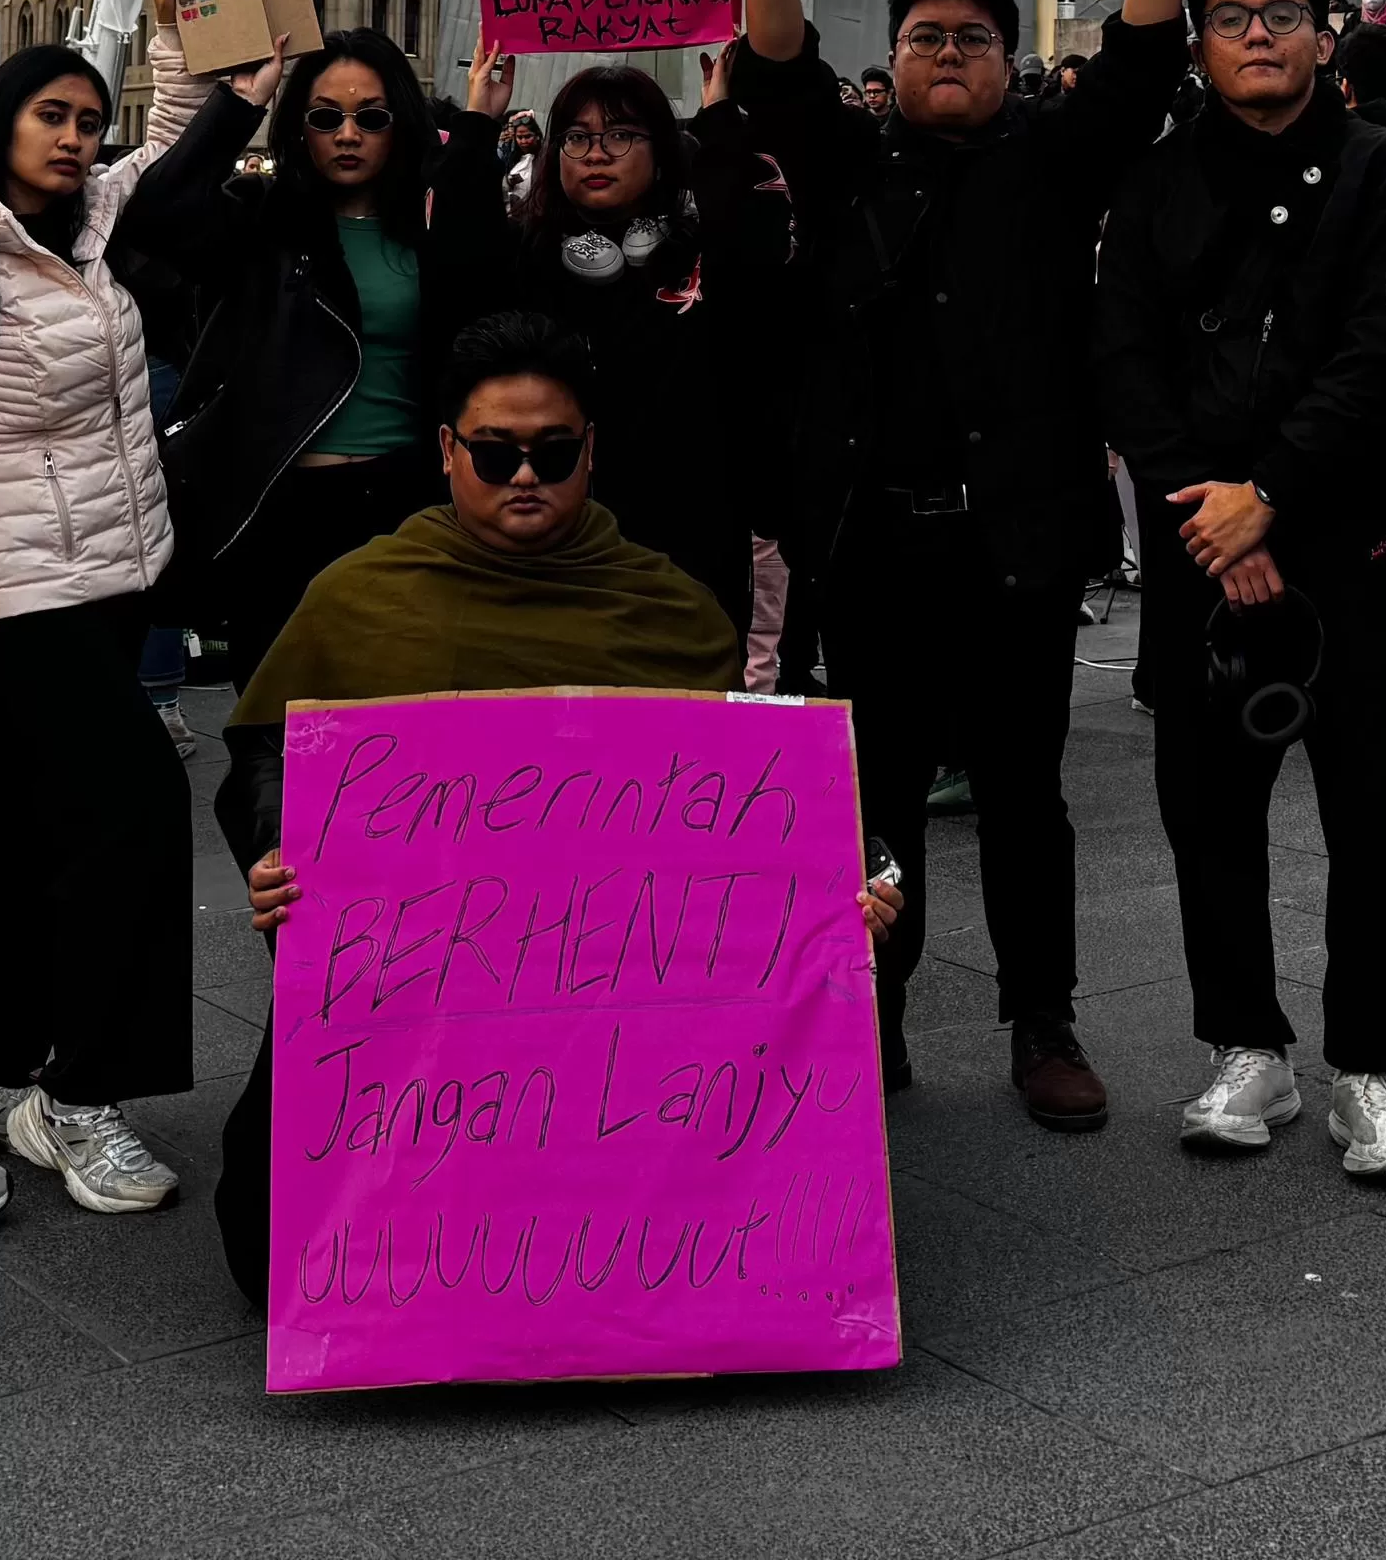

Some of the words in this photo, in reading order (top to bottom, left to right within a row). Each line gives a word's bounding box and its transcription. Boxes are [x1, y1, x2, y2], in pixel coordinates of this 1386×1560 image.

[313, 732, 798, 863] Pemerintah
[313, 868, 799, 1027] BERHENTI
[304, 1036, 557, 1192] Jangan
